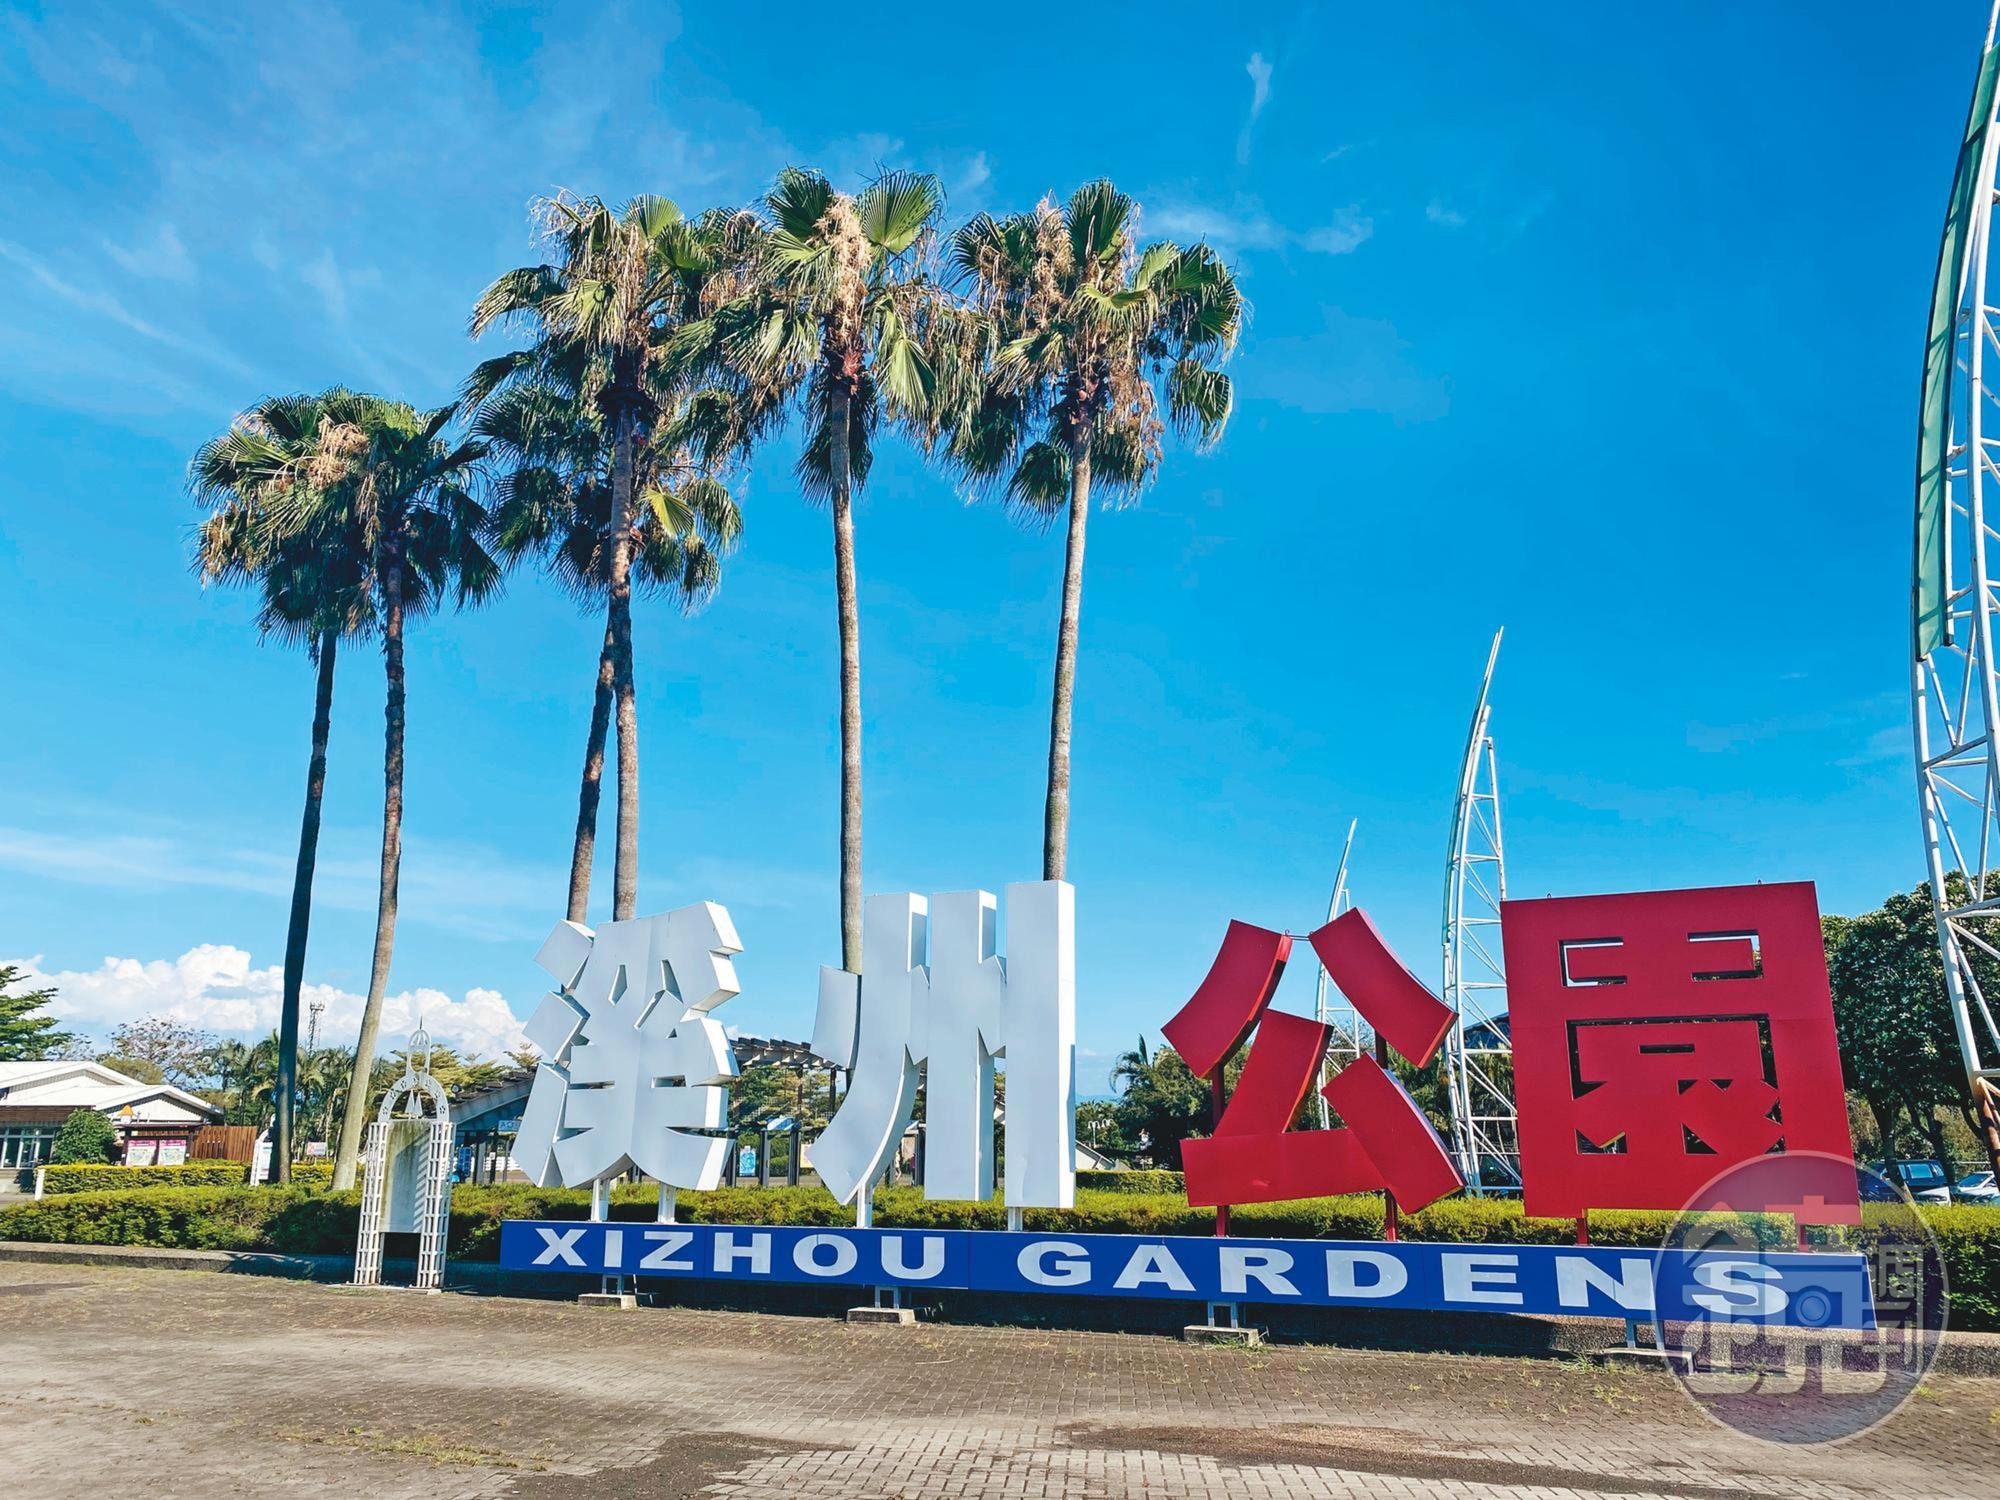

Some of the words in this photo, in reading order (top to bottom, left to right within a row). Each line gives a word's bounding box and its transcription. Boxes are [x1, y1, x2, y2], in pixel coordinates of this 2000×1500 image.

[510, 880, 1861, 1225] 溪州公園
[532, 1228, 946, 1280] XIZHOU
[1017, 1241, 1790, 1316] GARDENS
